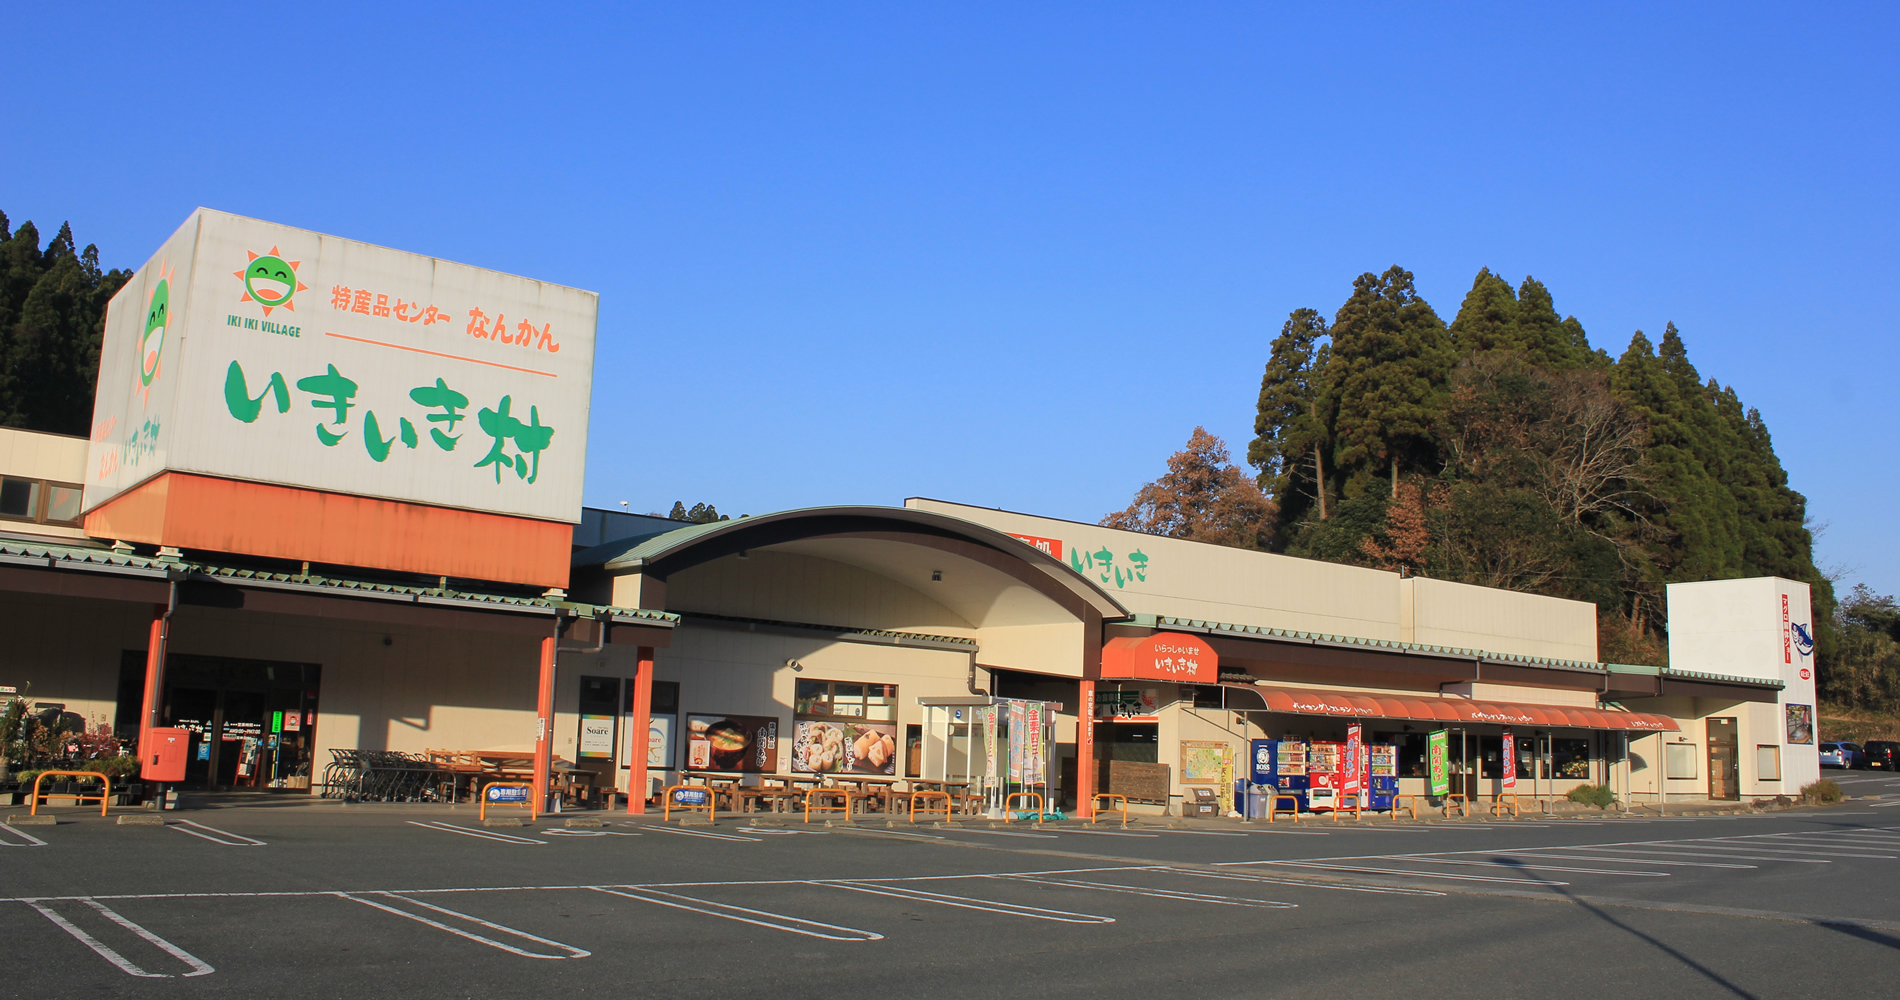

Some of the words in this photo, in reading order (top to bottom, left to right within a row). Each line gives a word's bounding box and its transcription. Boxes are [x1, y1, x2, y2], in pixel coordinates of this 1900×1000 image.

[227, 314, 242, 328] IKI
[244, 317, 259, 331] IKI
[261, 320, 302, 339] VILLAGE
[331, 284, 451, 326] 特産品センター
[466, 306, 560, 353] なんかん
[225, 360, 555, 484] いきいき村
[1071, 545, 1149, 589] いきいき
[1154, 643, 1200, 656] いらっしゃいませ
[1154, 656, 1198, 676] いきいき村
[1110, 701, 1143, 719] いきいき
[586, 726, 609, 736] Soare
[756, 727, 767, 767] 南関あげ
[1028, 709, 1040, 756] 金栗四三
[1431, 744, 1444, 782] 南関あげ
